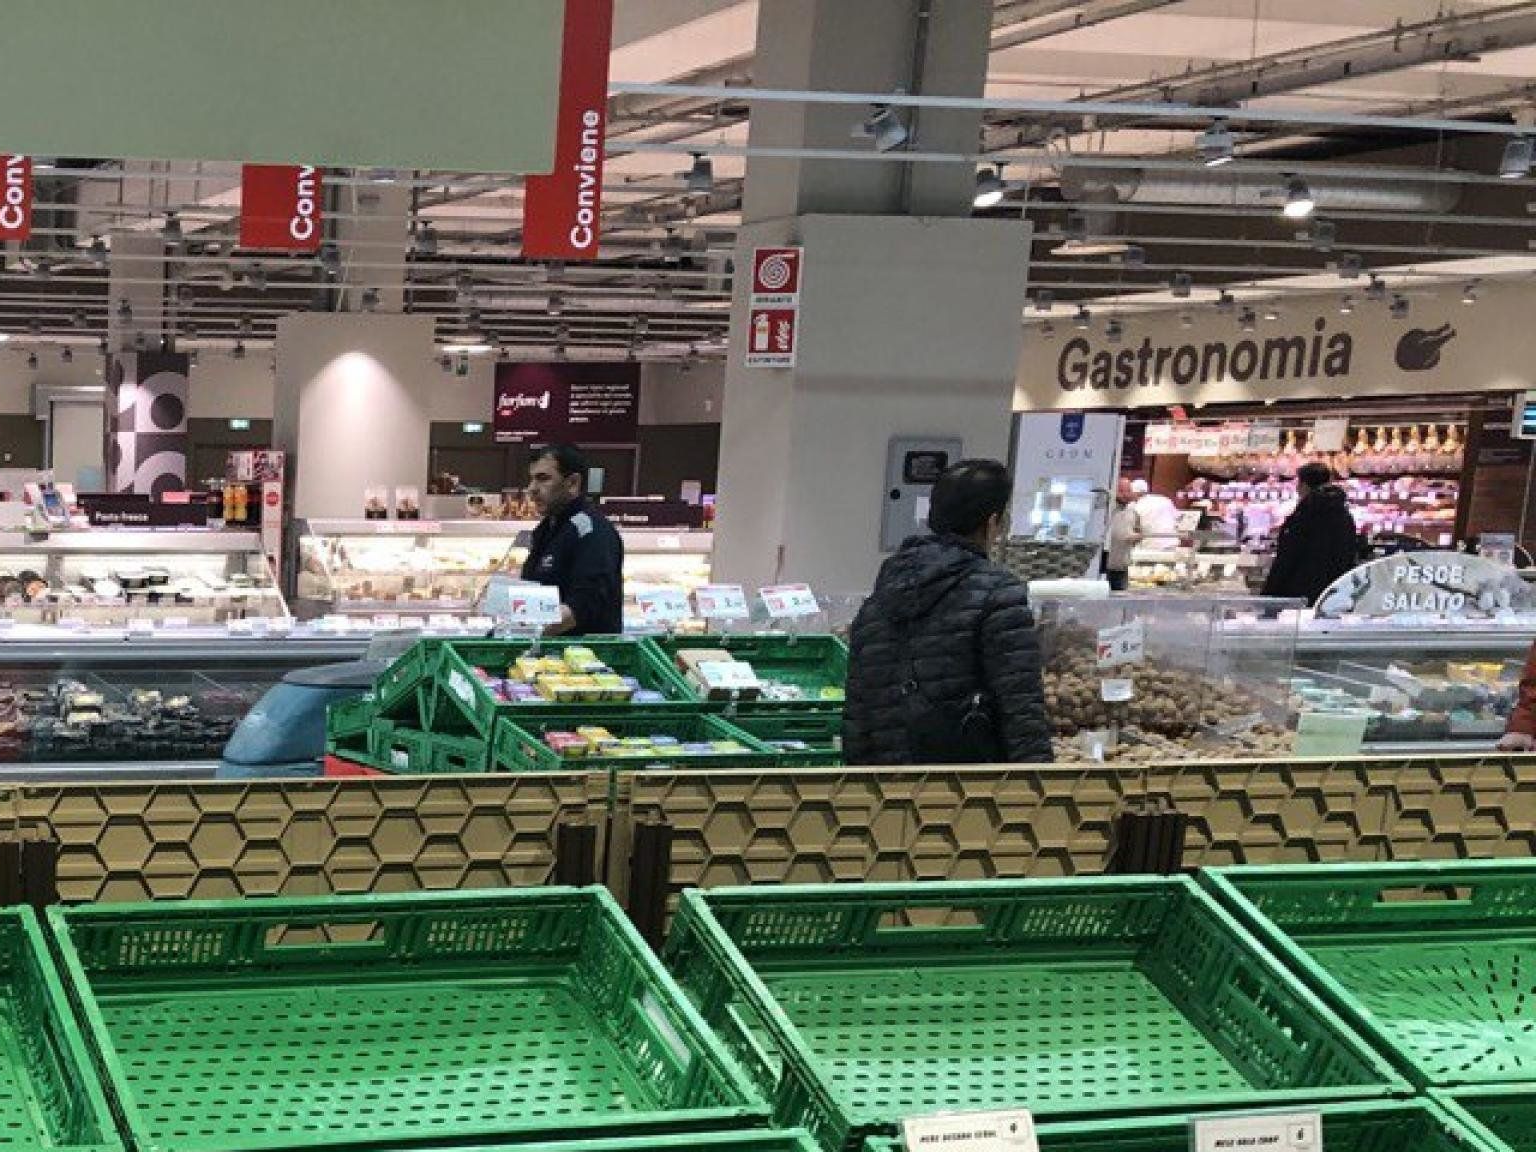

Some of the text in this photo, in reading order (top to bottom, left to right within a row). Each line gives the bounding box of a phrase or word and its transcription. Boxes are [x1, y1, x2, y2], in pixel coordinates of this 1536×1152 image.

[0, 154, 25, 230] Conv
[289, 165, 315, 241] Conv
[570, 110, 601, 249] Conviene
[1057, 316, 1353, 392] Gastronomia
[1381, 592, 1465, 611] SALATO
[1393, 565, 1465, 584] PESCE
